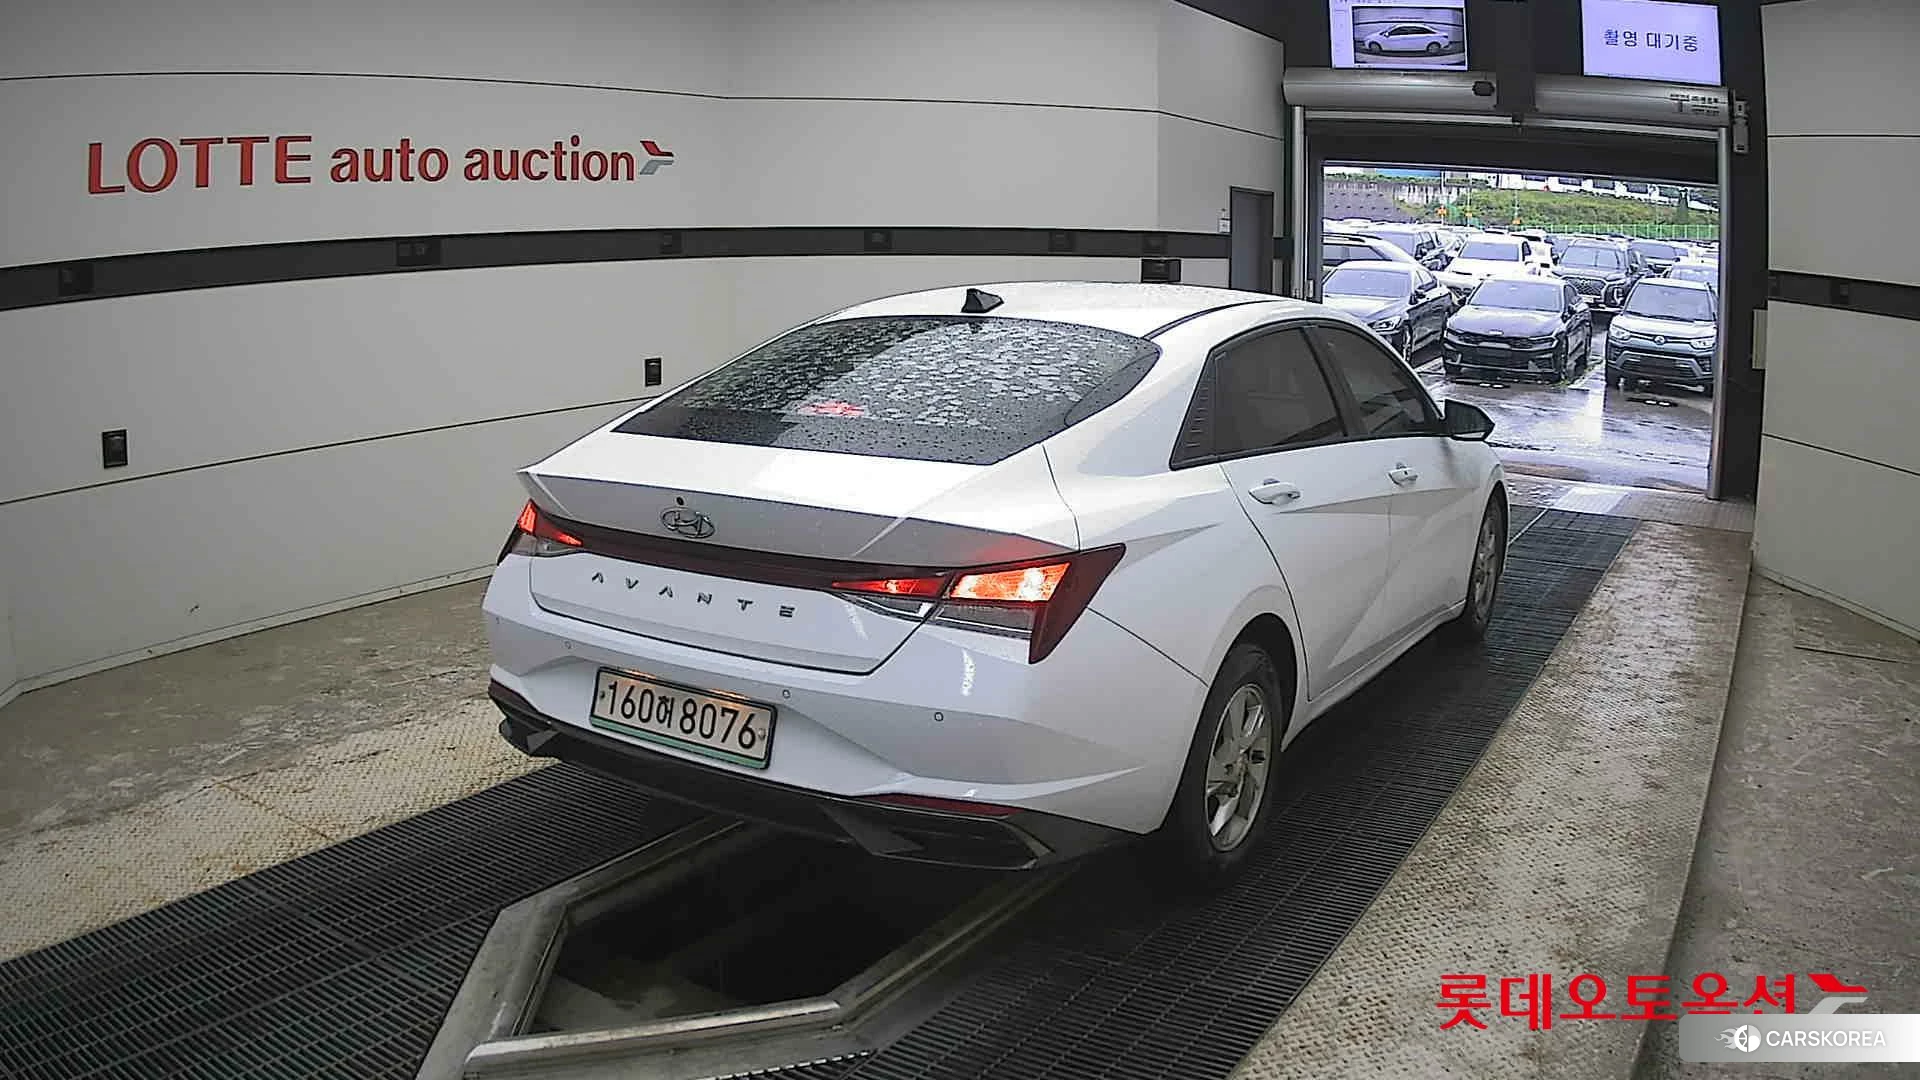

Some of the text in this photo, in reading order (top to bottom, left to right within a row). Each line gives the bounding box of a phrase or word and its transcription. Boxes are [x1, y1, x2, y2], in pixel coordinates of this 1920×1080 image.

[1646, 32, 1698, 52] 대기중
[88, 134, 635, 195] LOTTE auto auction
[591, 571, 796, 619] AVANTE
